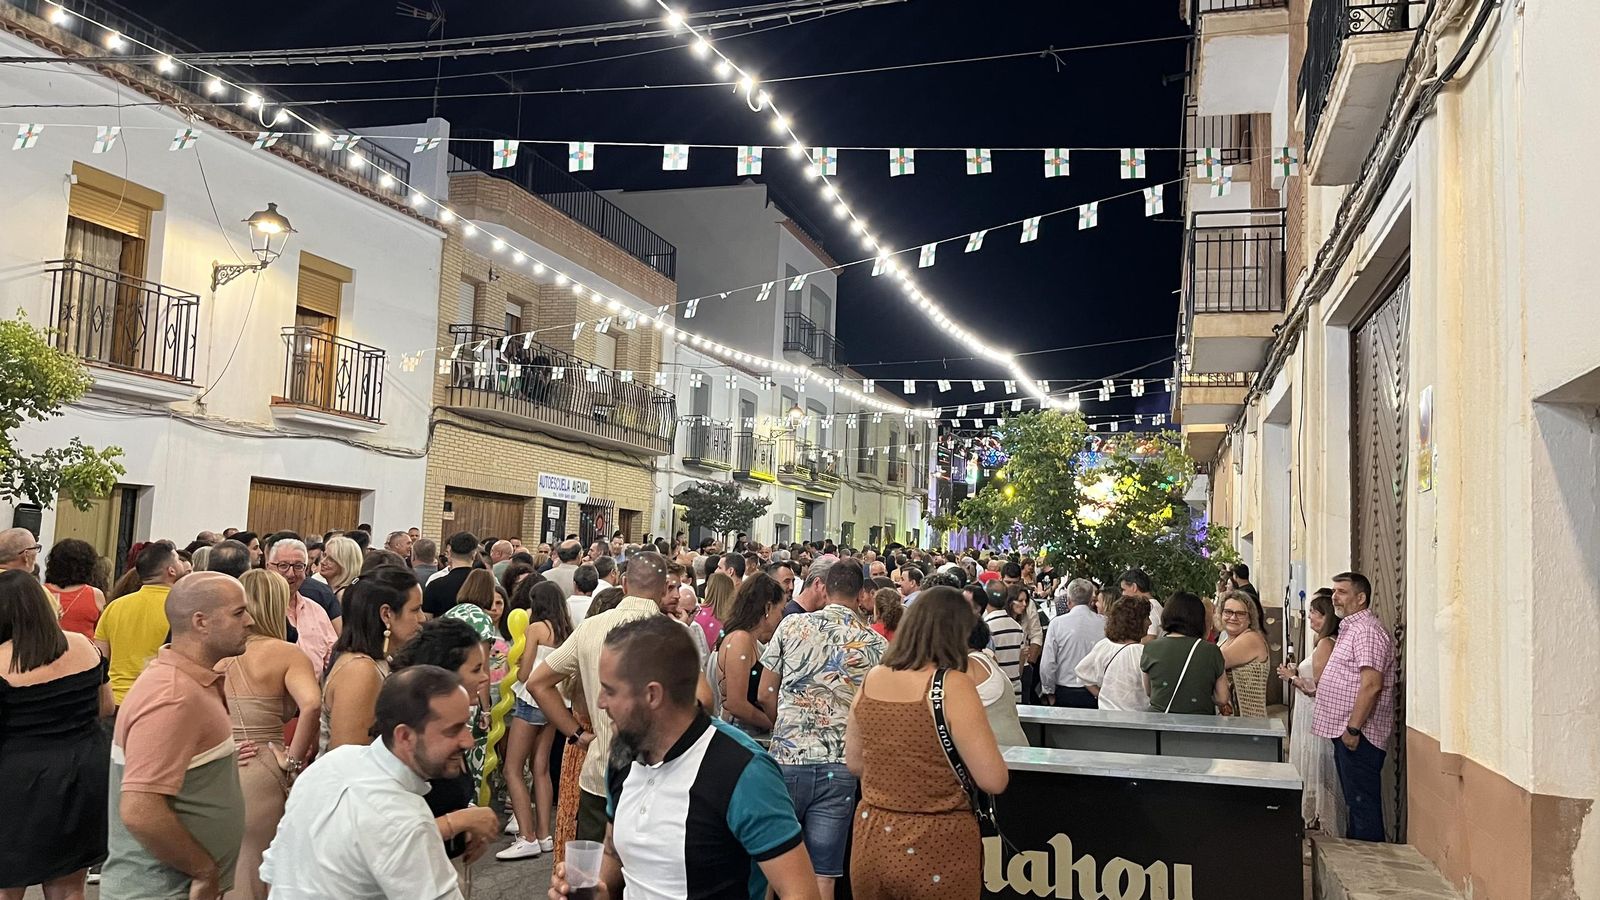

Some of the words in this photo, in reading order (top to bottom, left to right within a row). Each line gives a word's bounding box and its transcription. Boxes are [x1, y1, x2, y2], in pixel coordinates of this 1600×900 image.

[539, 475, 571, 492] AUTOESCUELA
[572, 480, 589, 494] AVENIDA
[938, 725, 953, 752] TOUS
